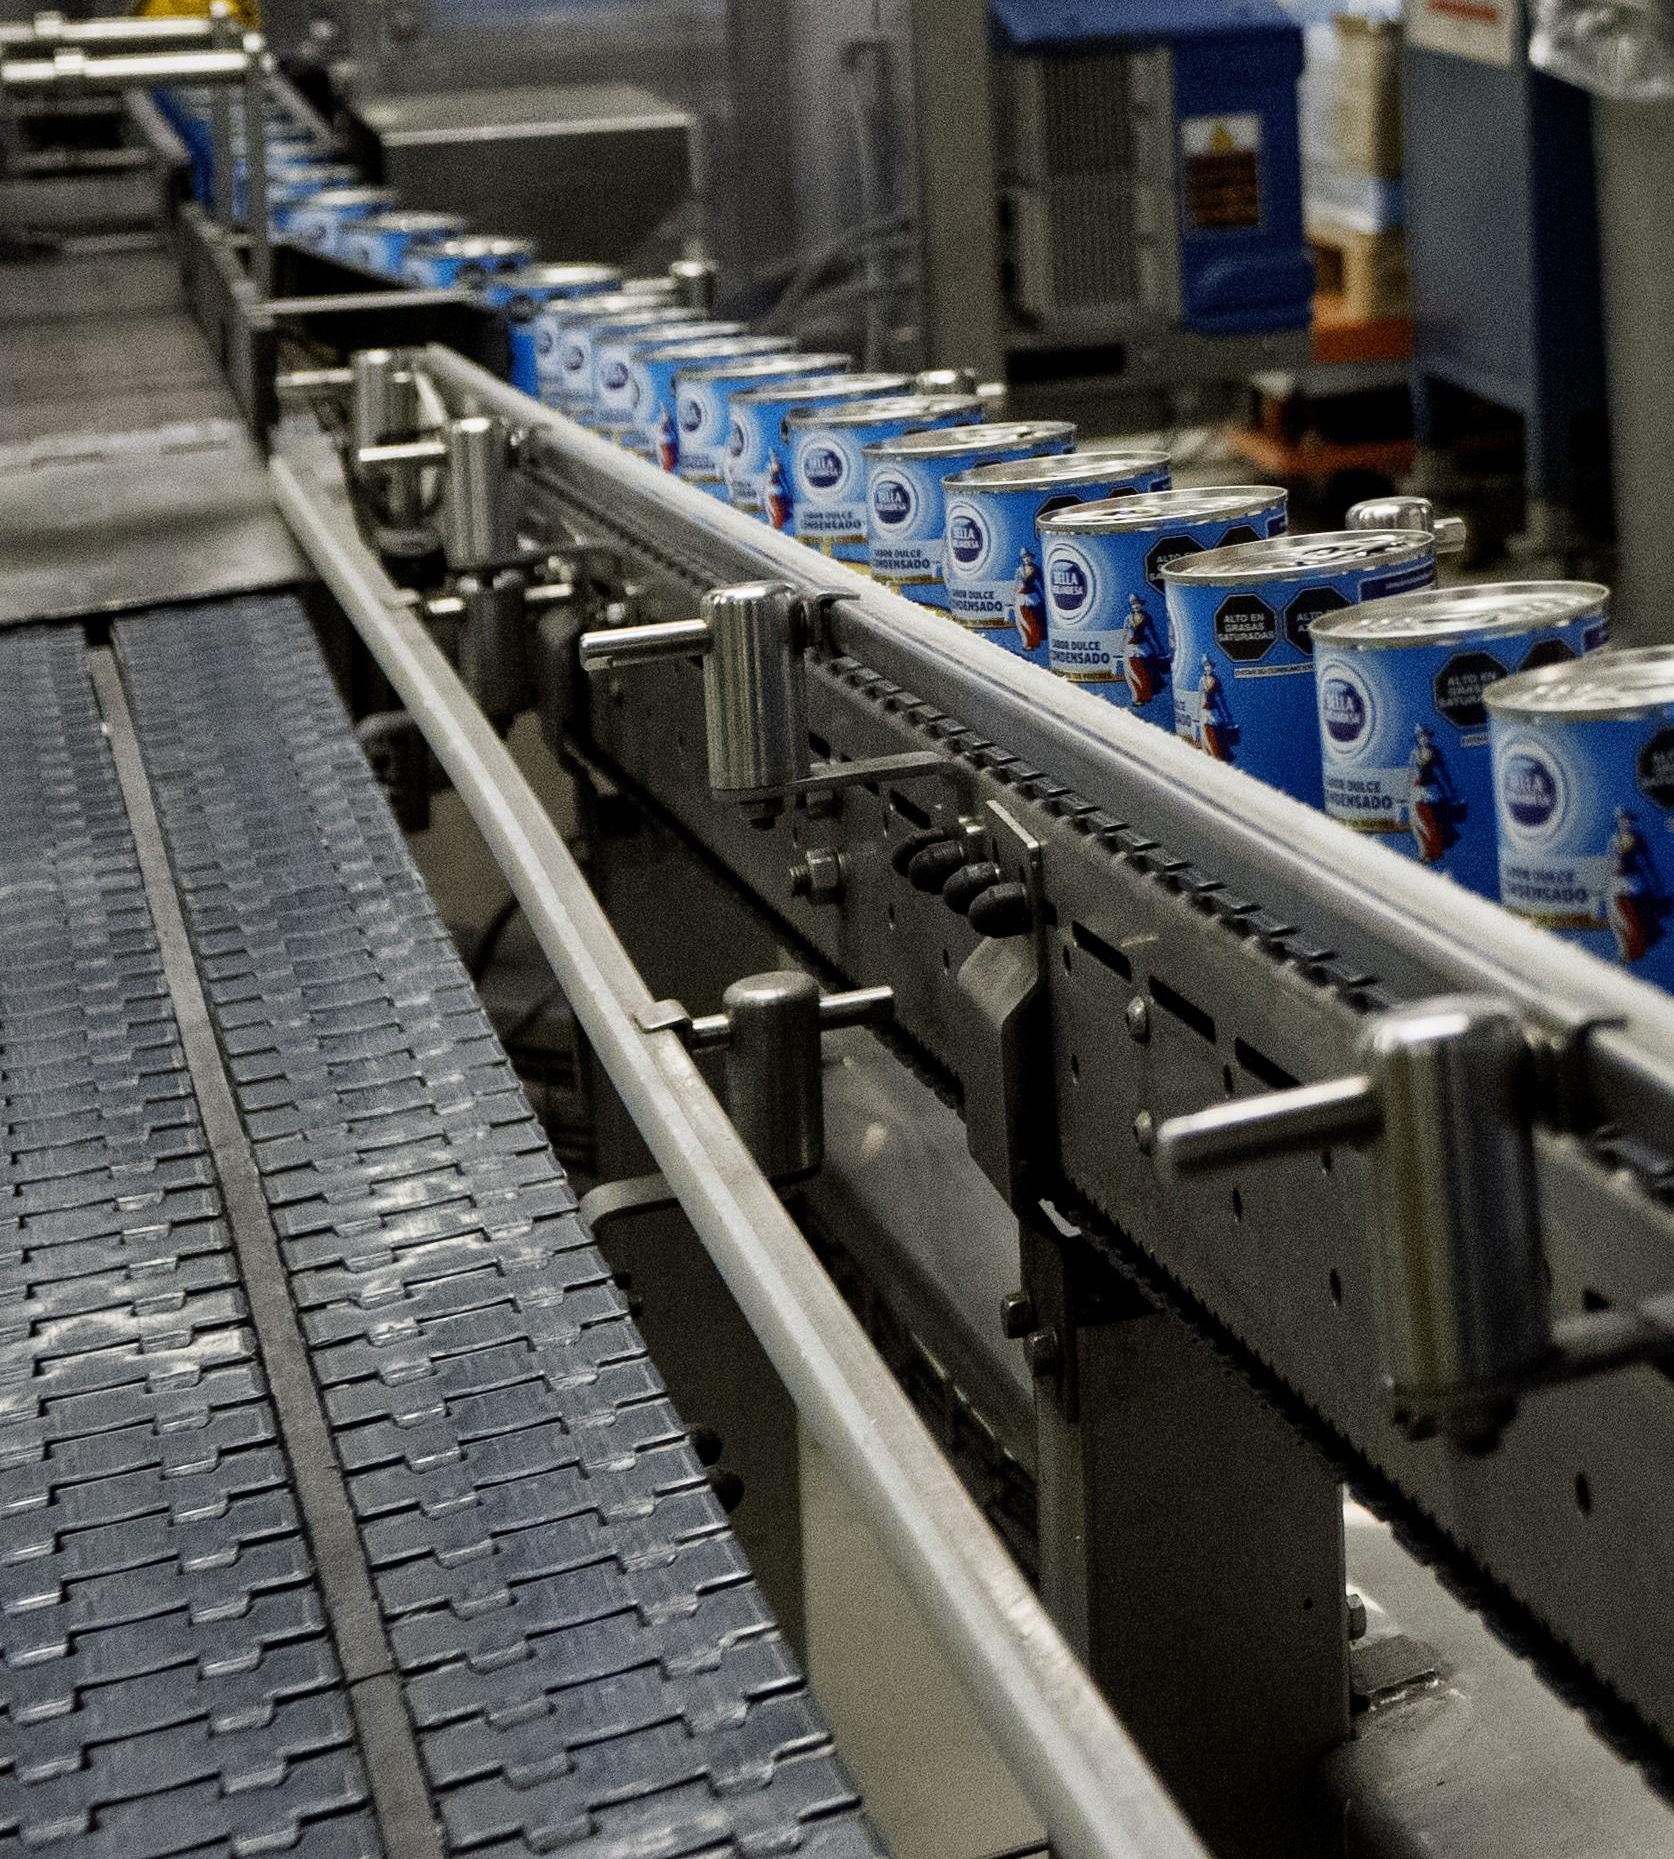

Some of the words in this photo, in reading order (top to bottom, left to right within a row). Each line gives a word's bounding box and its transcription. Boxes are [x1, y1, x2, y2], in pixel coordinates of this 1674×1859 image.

[968, 590, 994, 599] DULCE
[1223, 614, 1248, 623] ALTO
[1250, 613, 1264, 622] EN
[1225, 622, 1264, 632] GRASAS
[1217, 631, 1276, 642] SATURADAS
[1071, 640, 1100, 650] DULCE
